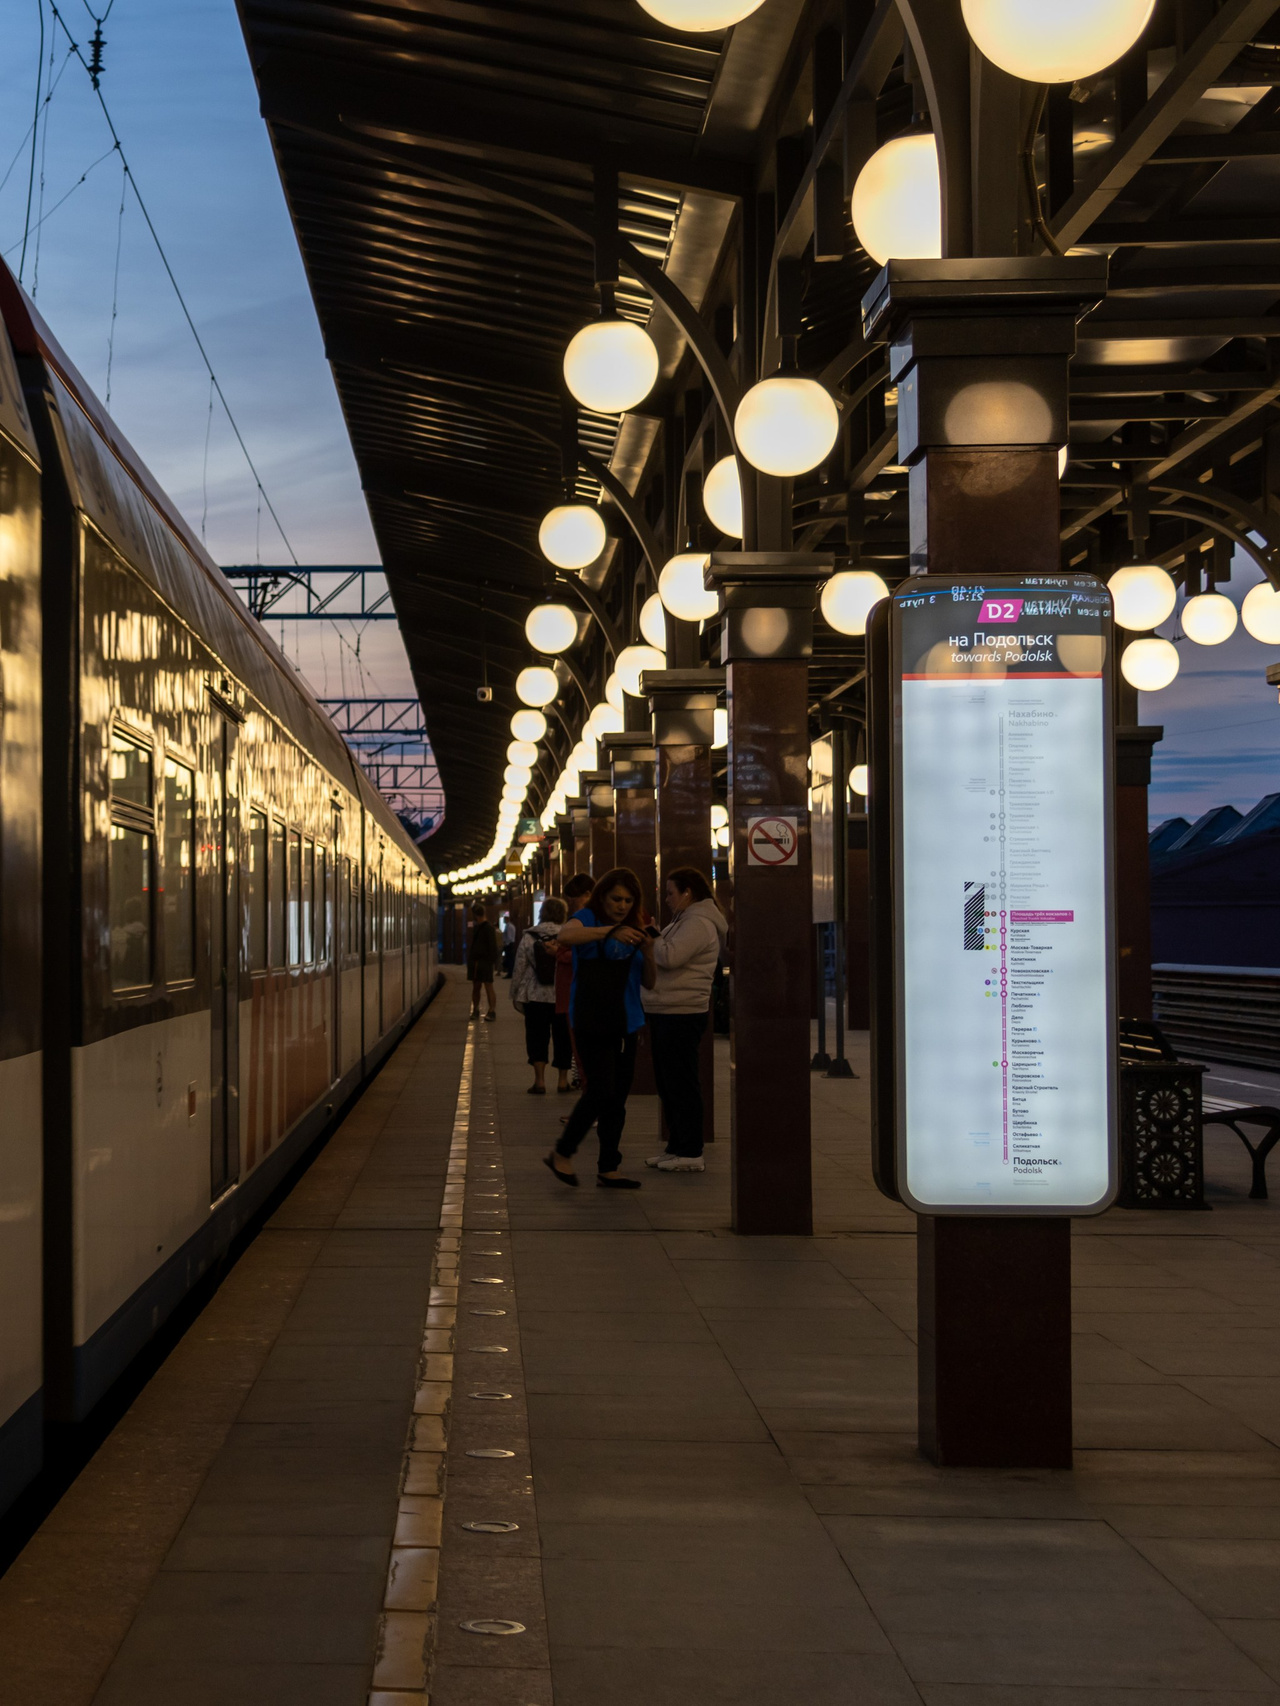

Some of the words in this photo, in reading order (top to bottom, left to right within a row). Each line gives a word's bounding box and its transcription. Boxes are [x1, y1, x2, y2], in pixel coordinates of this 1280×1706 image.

[986, 604, 1014, 618] D2
[949, 635, 968, 646] на
[974, 632, 1053, 648] Подольск
[951, 652, 1001, 662] towards
[1004, 650, 1052, 662] Podolsk
[1008, 710, 1054, 718] Нахабино
[526, 820, 536, 834] 3
[1013, 1157, 1058, 1166] Подольск
